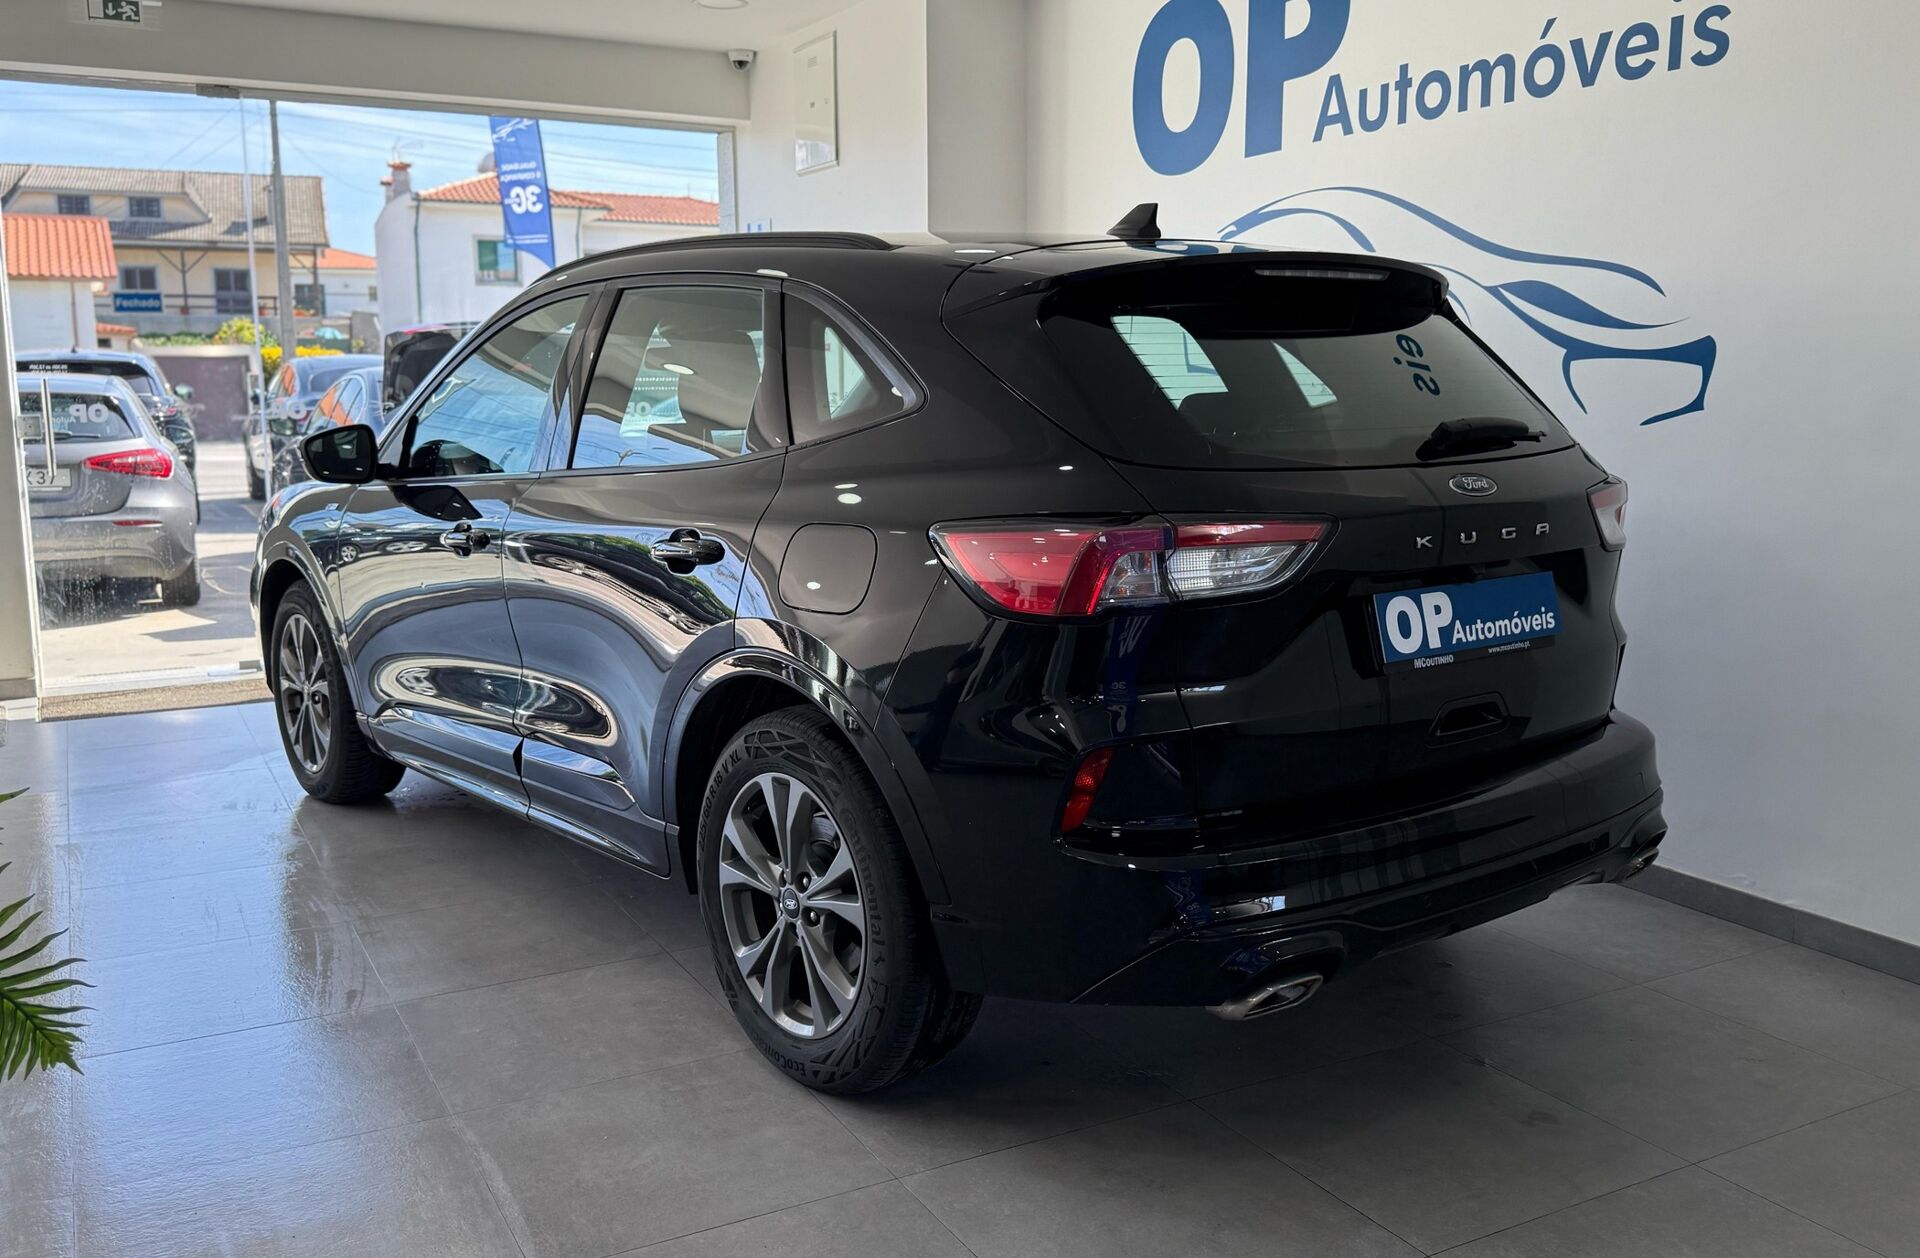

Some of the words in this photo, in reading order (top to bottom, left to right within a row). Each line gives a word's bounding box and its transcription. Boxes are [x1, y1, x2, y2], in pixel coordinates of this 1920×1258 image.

[1132, 0, 1351, 176] OP
[1312, 0, 1732, 143] Automóveis
[115, 296, 160, 308] Fechado
[1462, 476, 1489, 490] Ford
[1415, 522, 1550, 550] KUGA
[1385, 591, 1453, 654] OP
[1452, 606, 1556, 645] Automóveis
